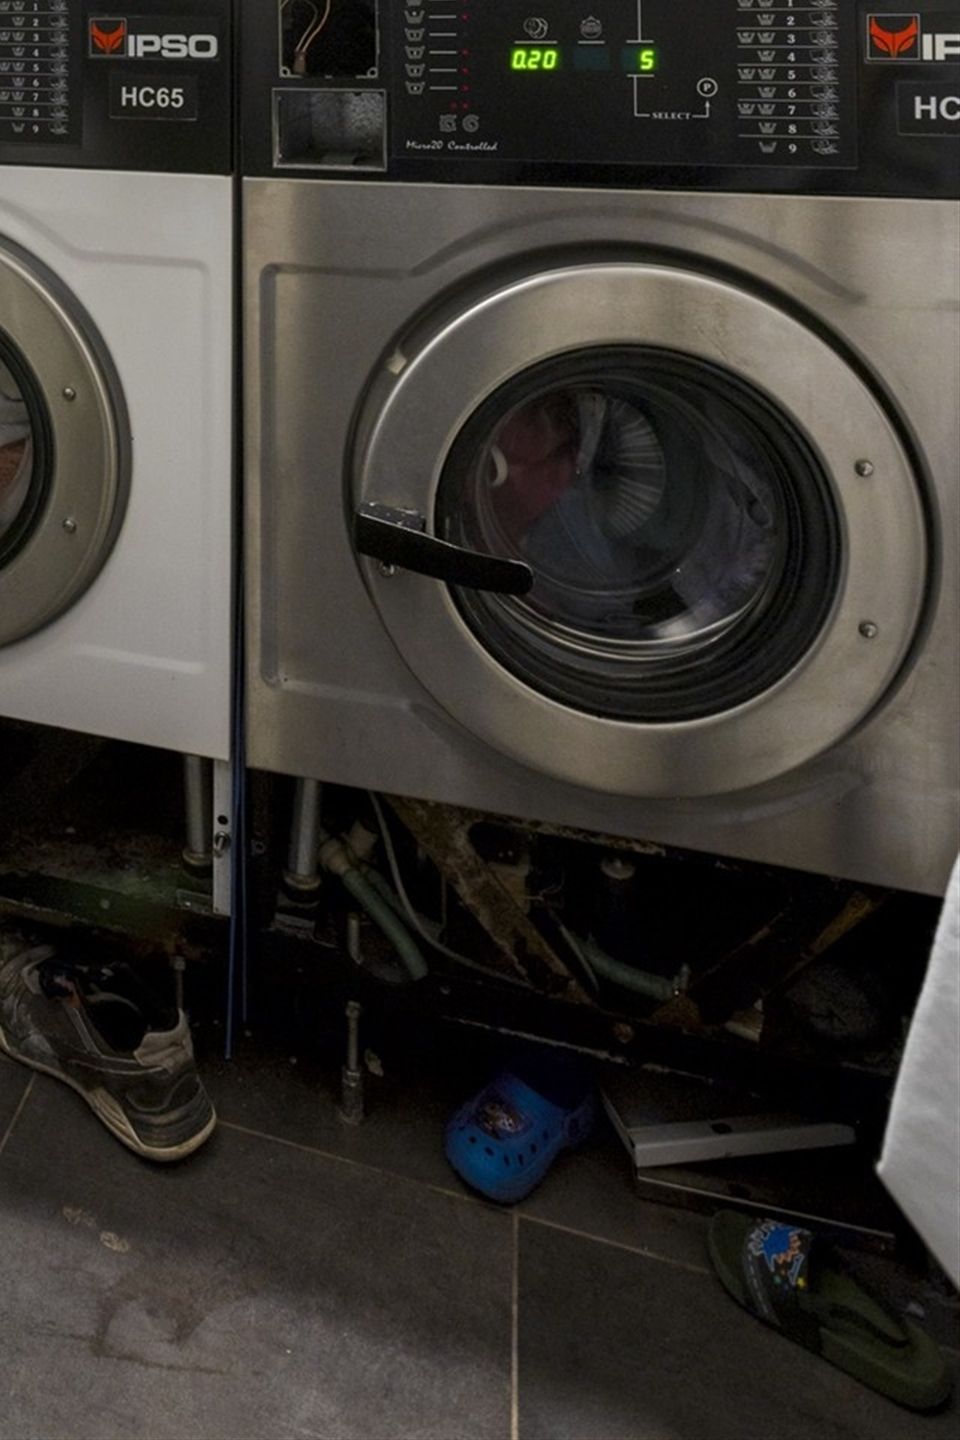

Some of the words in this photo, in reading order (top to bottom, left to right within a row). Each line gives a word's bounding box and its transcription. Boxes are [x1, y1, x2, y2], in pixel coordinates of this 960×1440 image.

[32, 18, 39, 27] 2
[786, 15, 796, 26] 2
[32, 33, 39, 42] 3
[787, 33, 796, 44] 3
[128, 34, 218, 58] IPSO
[32, 48, 39, 58] 4
[787, 52, 796, 62] 4
[641, 50, 654, 70] 5
[32, 63, 39, 73] 5
[787, 69, 796, 80] 5
[32, 78, 39, 88] 6
[32, 93, 39, 101] 7
[121, 86, 184, 108] HC65
[788, 87, 797, 98] 6
[788, 105, 796, 115] 7
[914, 96, 960, 121] HC
[651, 112, 691, 120] SELECT
[32, 123, 39, 133] 9
[788, 123, 797, 134] 8
[406, 140, 444, 150] Micro20
[447, 140, 498, 151] Controlled
[788, 143, 797, 154] 9
